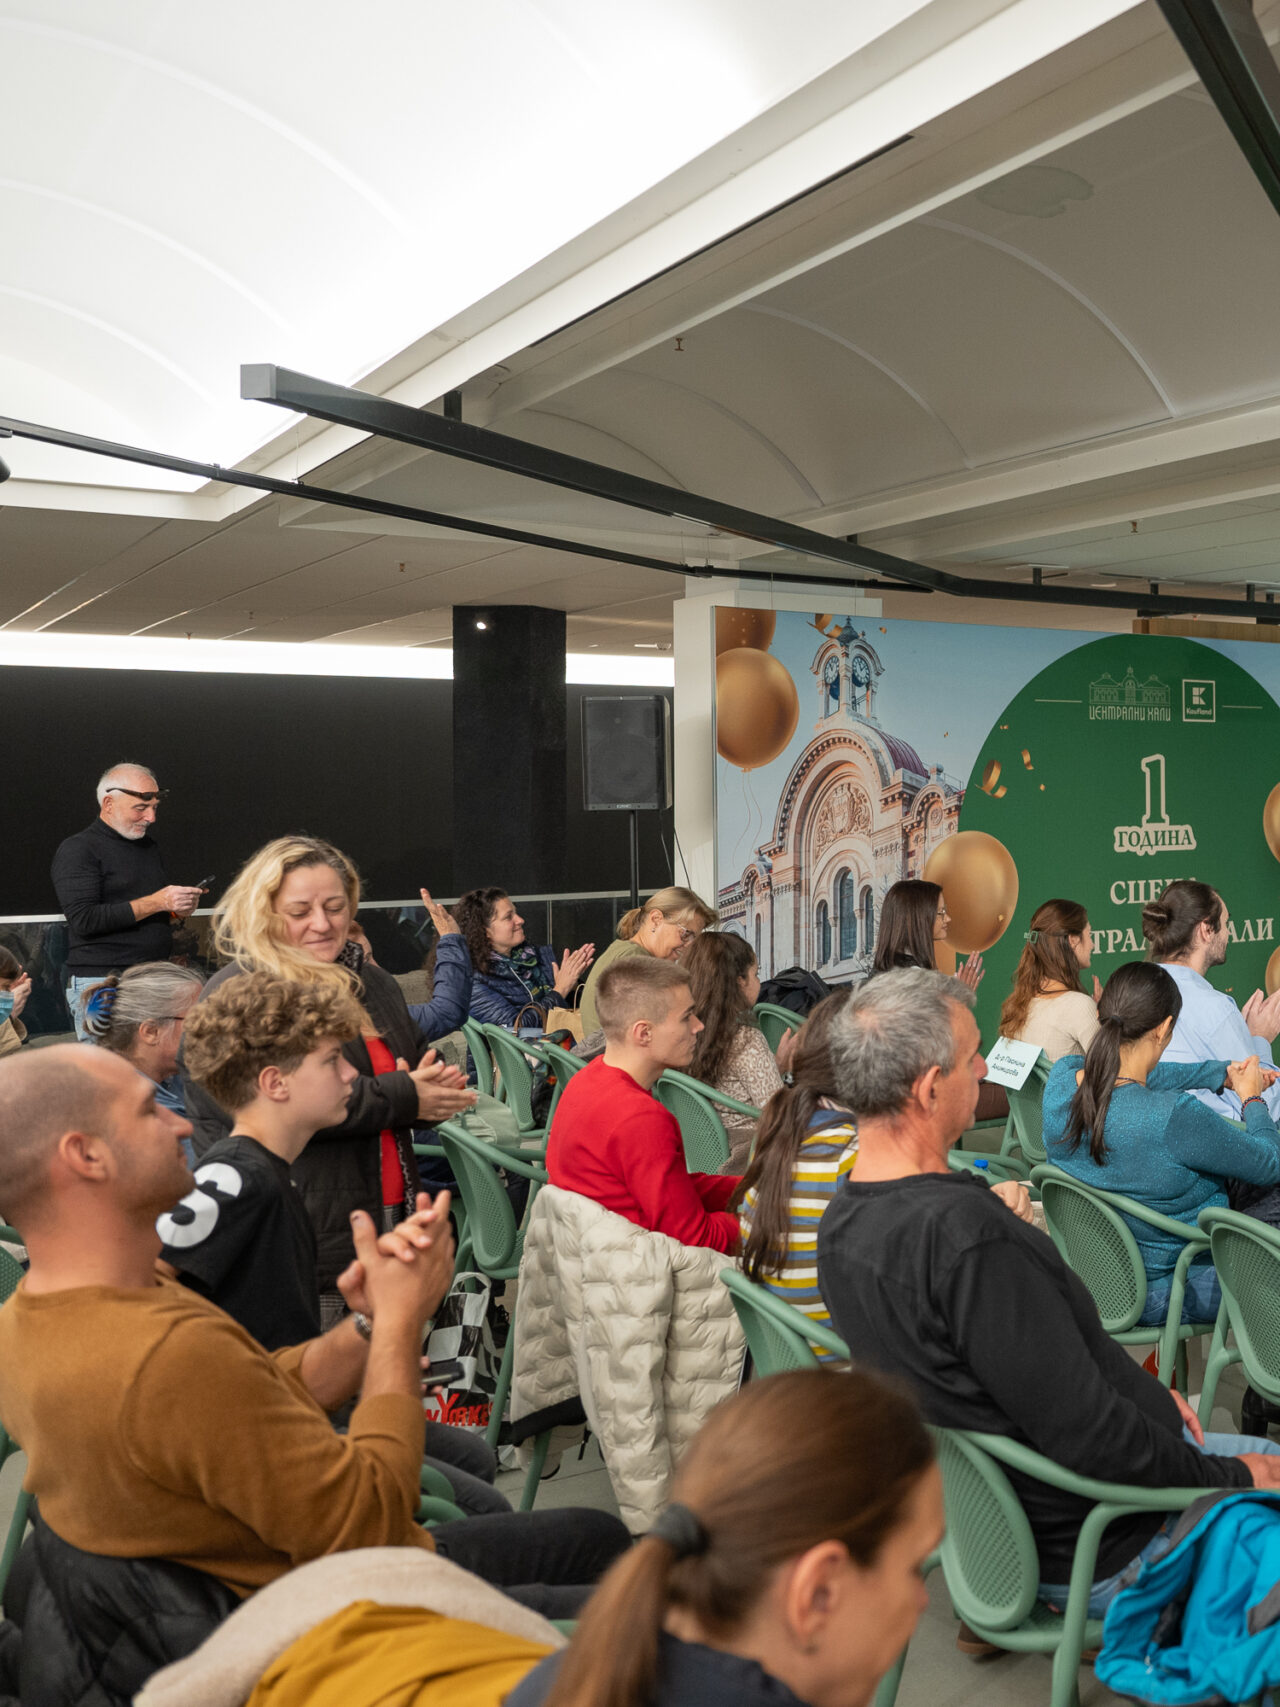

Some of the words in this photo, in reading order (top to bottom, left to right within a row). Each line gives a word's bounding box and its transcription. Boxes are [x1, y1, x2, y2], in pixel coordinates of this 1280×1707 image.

[1186, 708, 1212, 716] Kaufland
[1118, 829, 1193, 851] ГОДИНА
[1109, 877, 1198, 906] СЦЕ
[1227, 918, 1275, 944] АЛИ
